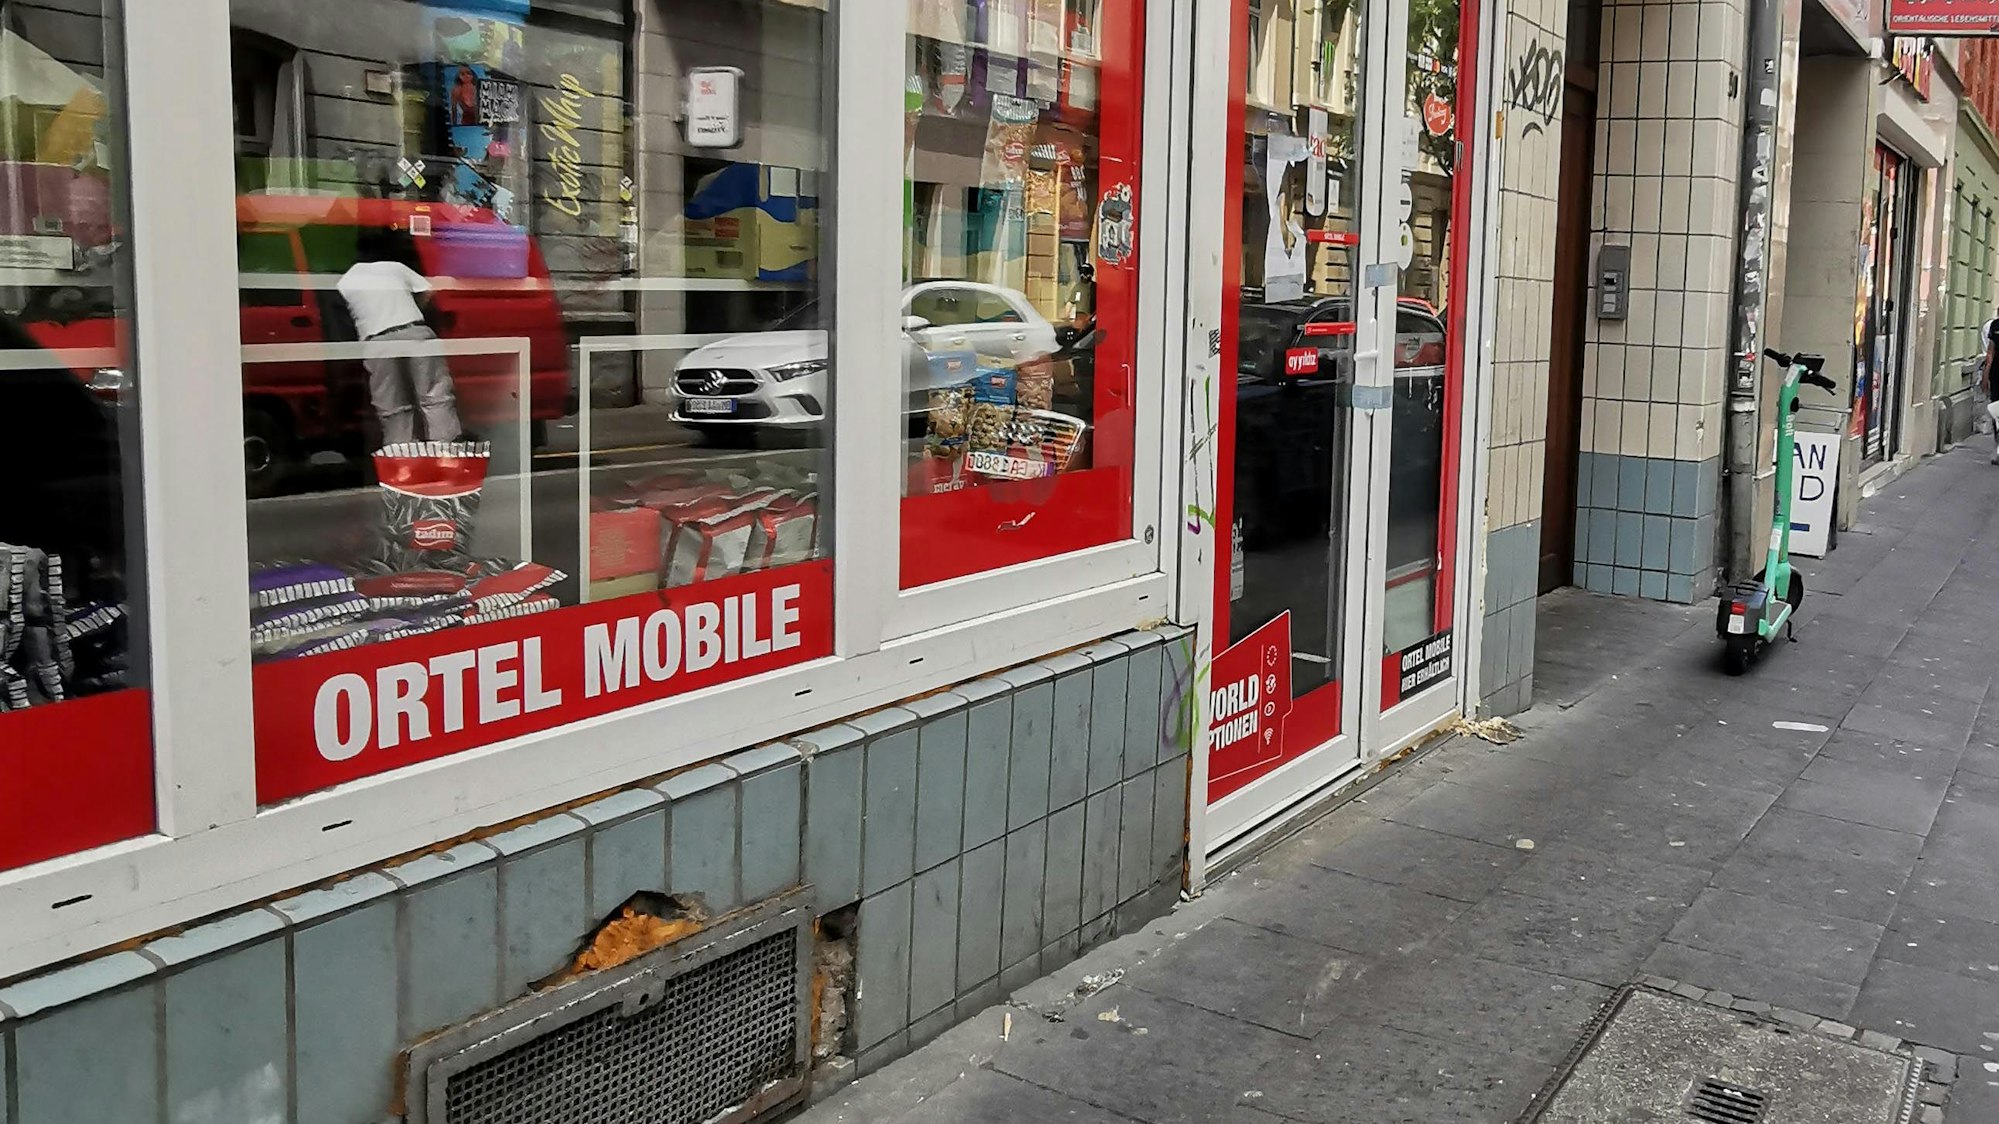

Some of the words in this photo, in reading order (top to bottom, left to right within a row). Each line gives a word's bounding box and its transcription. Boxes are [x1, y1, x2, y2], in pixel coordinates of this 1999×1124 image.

[539, 74, 595, 147] Whip
[543, 146, 583, 216] Exotic
[1784, 415, 1795, 436] Bolt
[313, 636, 562, 762] ORTEL
[583, 583, 801, 698] MOBILE
[1402, 647, 1424, 673] ORTEL
[1425, 634, 1451, 660] MOBILE
